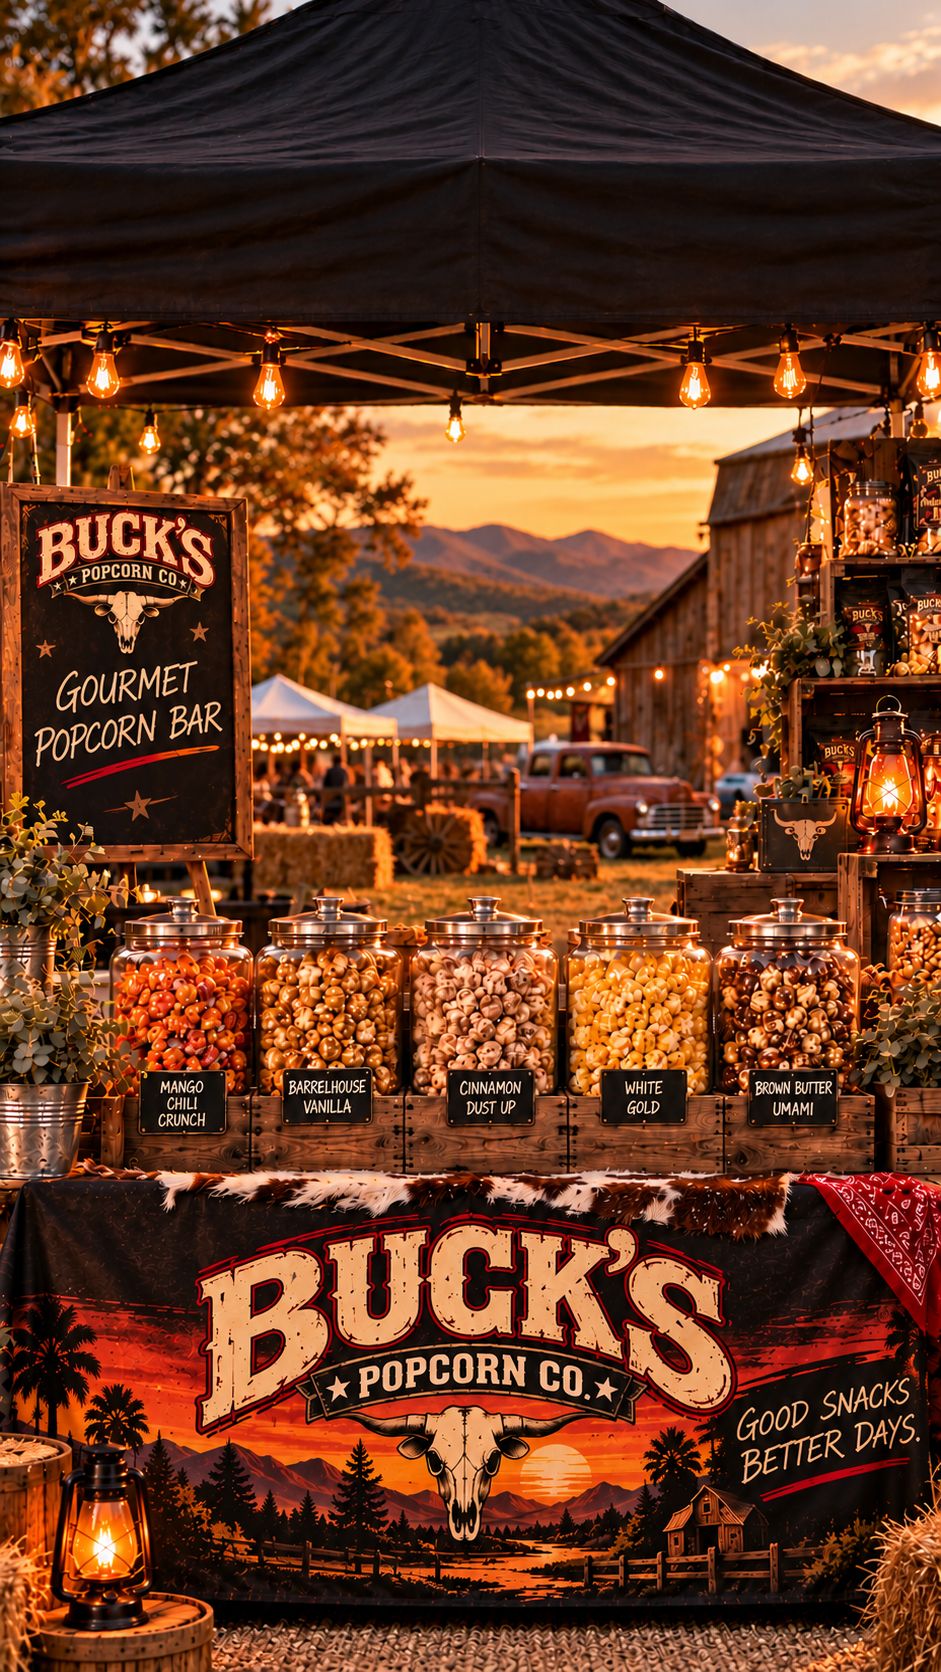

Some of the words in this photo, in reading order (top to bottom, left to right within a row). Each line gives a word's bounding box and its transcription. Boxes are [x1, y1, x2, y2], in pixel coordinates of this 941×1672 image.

[37, 510, 216, 588] BUCK'S
[81, 565, 153, 584] POPCORN
[158, 569, 177, 586] CO
[55, 660, 199, 713] GOURMET
[34, 710, 157, 768] POPCORN
[168, 701, 223, 740] BAR
[160, 1080, 204, 1095] MANGO
[288, 1079, 367, 1095] BARRELHOUSE
[459, 1080, 522, 1096] CINNAMON
[624, 1080, 664, 1096] WHITE
[755, 1080, 792, 1096] BROWN
[794, 1080, 833, 1096] BUTTER
[167, 1098, 198, 1111] CHILI
[303, 1098, 352, 1115] VANILLA
[466, 1101, 497, 1116] DUST
[500, 1100, 517, 1116] UP
[626, 1100, 661, 1115] GOLD
[772, 1101, 814, 1116] UMAMI
[158, 1112, 206, 1128] CRUNCH
[200, 1224, 733, 1428] BUCK'S
[358, 1353, 527, 1400] POPCORN
[539, 1365, 592, 1401] CO.
[736, 1400, 810, 1442] GOOD
[820, 1376, 911, 1421] SNACKS
[740, 1429, 846, 1485] BETTER
[853, 1413, 921, 1453] DAYS.
